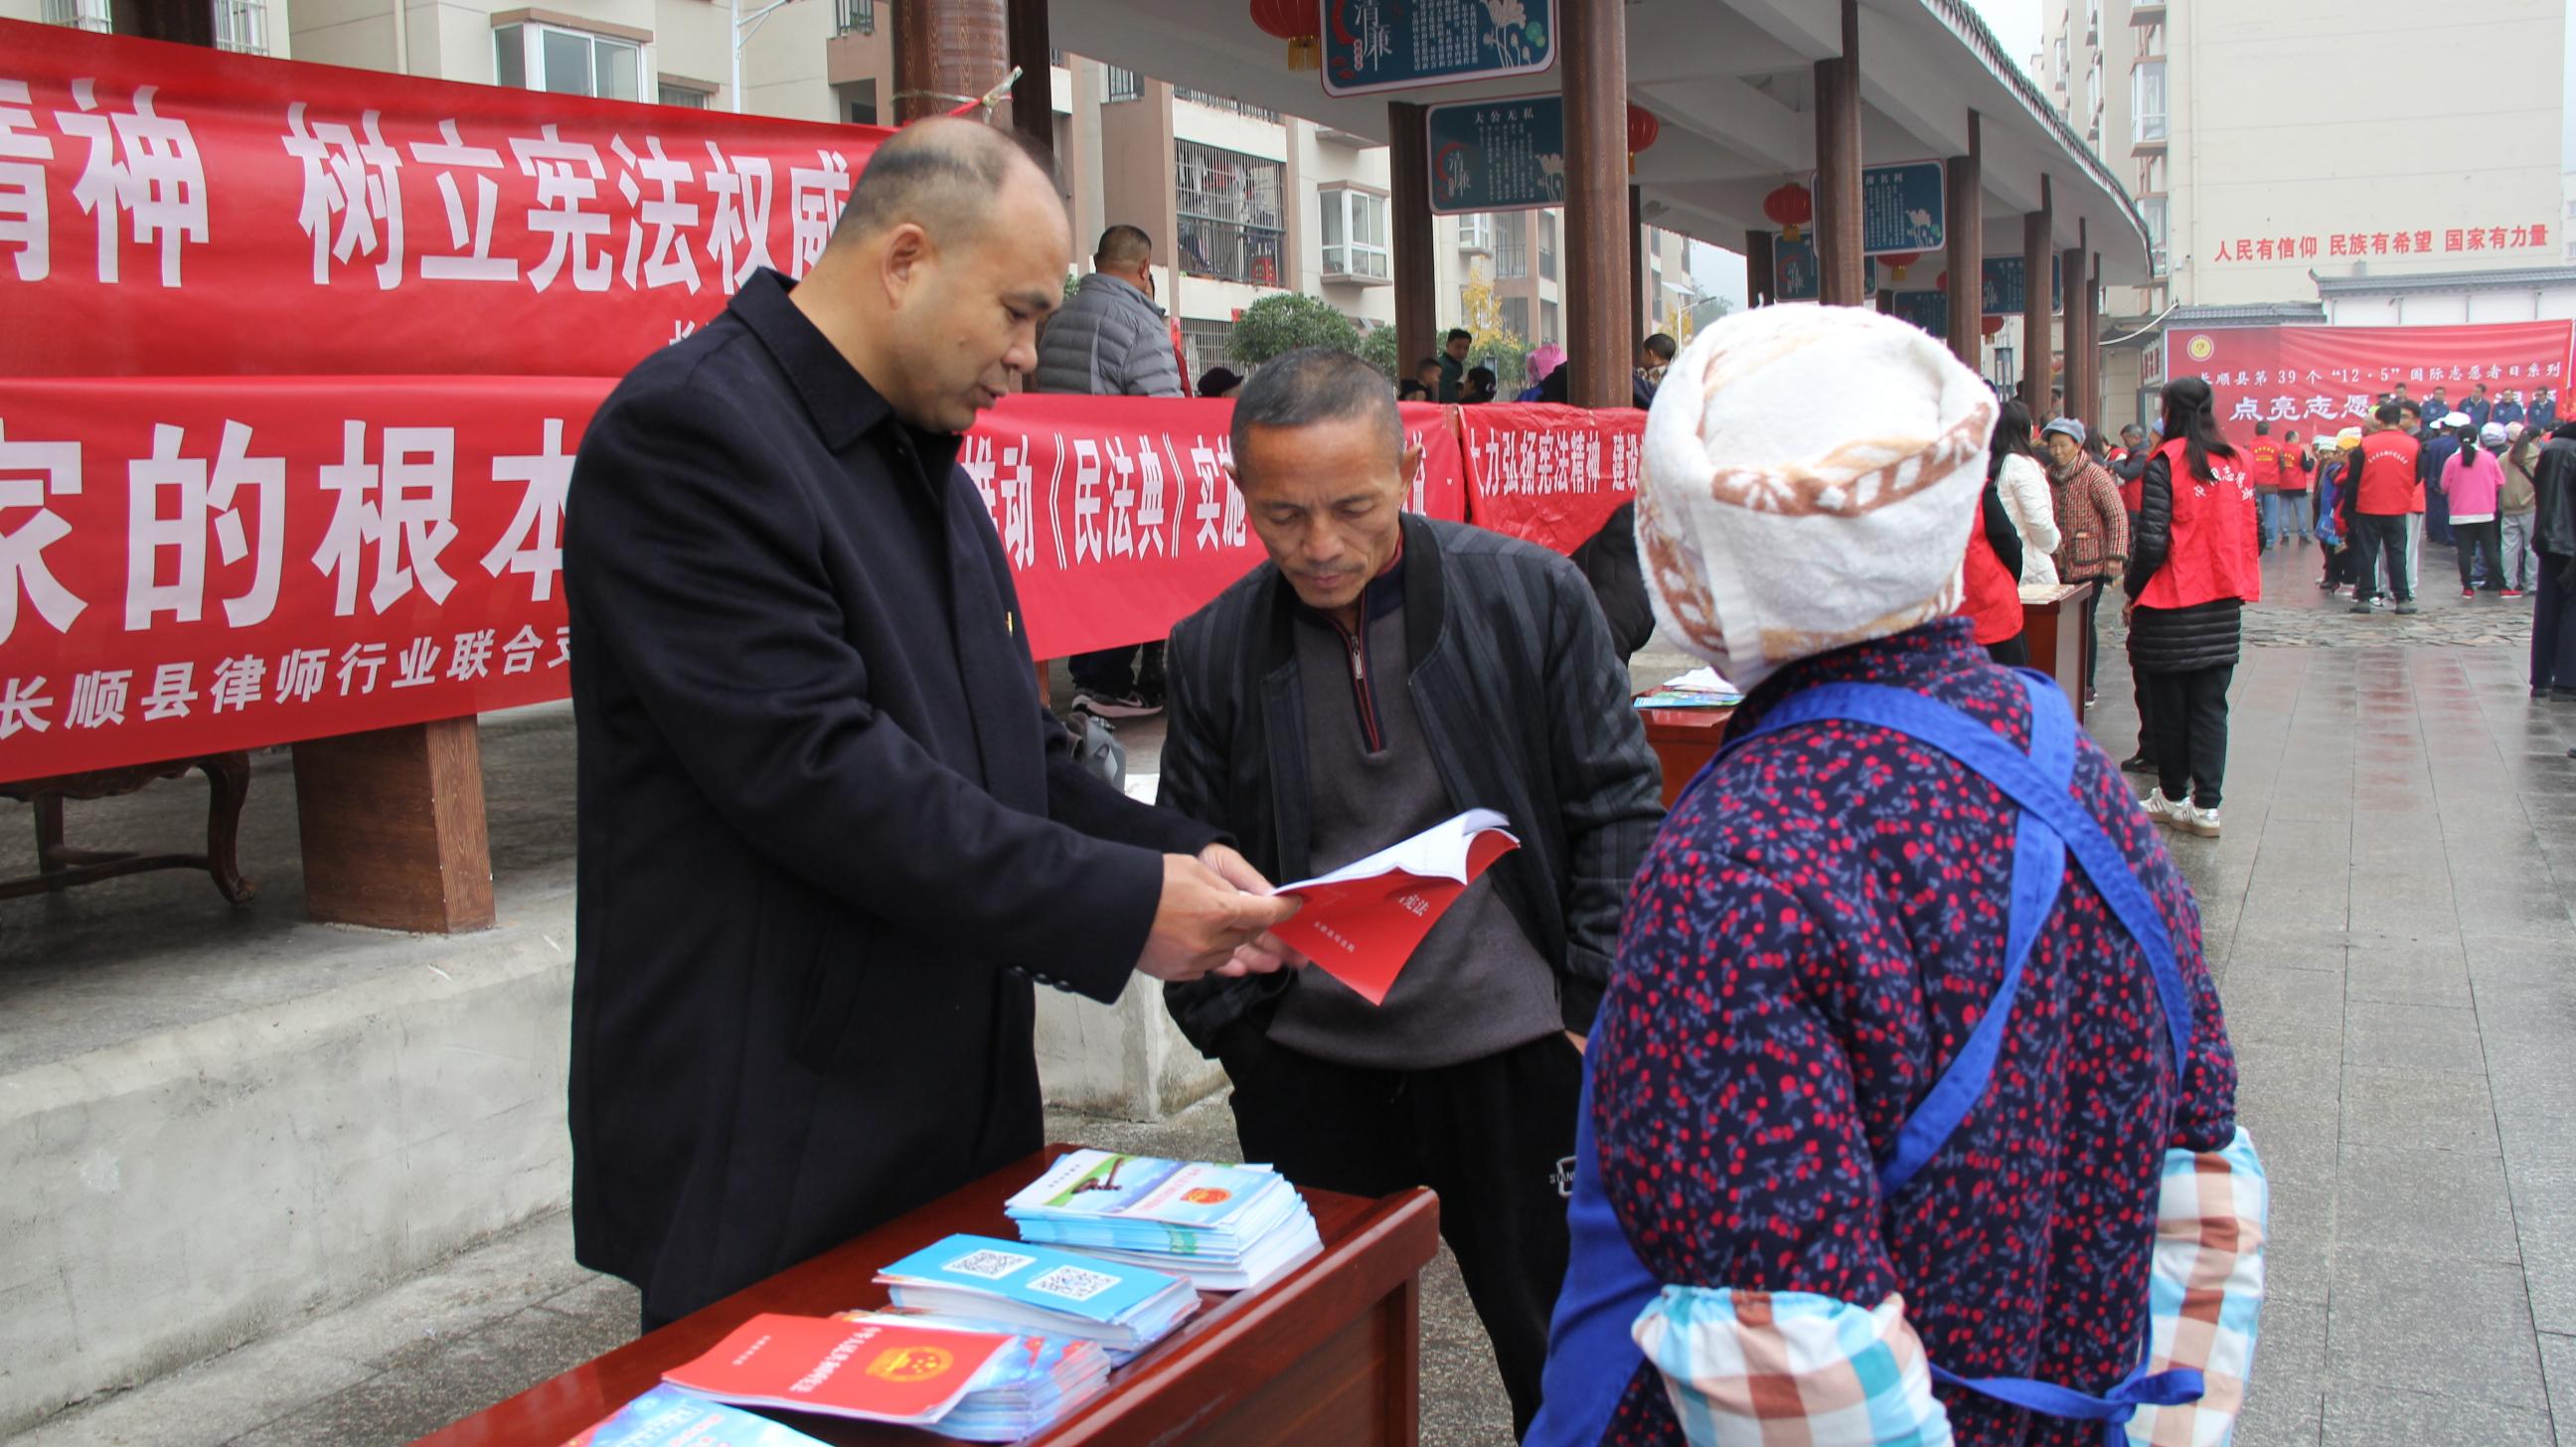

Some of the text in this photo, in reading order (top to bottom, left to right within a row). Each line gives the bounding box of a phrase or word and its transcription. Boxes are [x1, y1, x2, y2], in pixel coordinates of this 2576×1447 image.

[282, 102, 850, 295] 树立宪法权威
[2214, 224, 2549, 262] 人民有信仰 民族有希望 国家有力量
[1612, 431, 1645, 492] 建设
